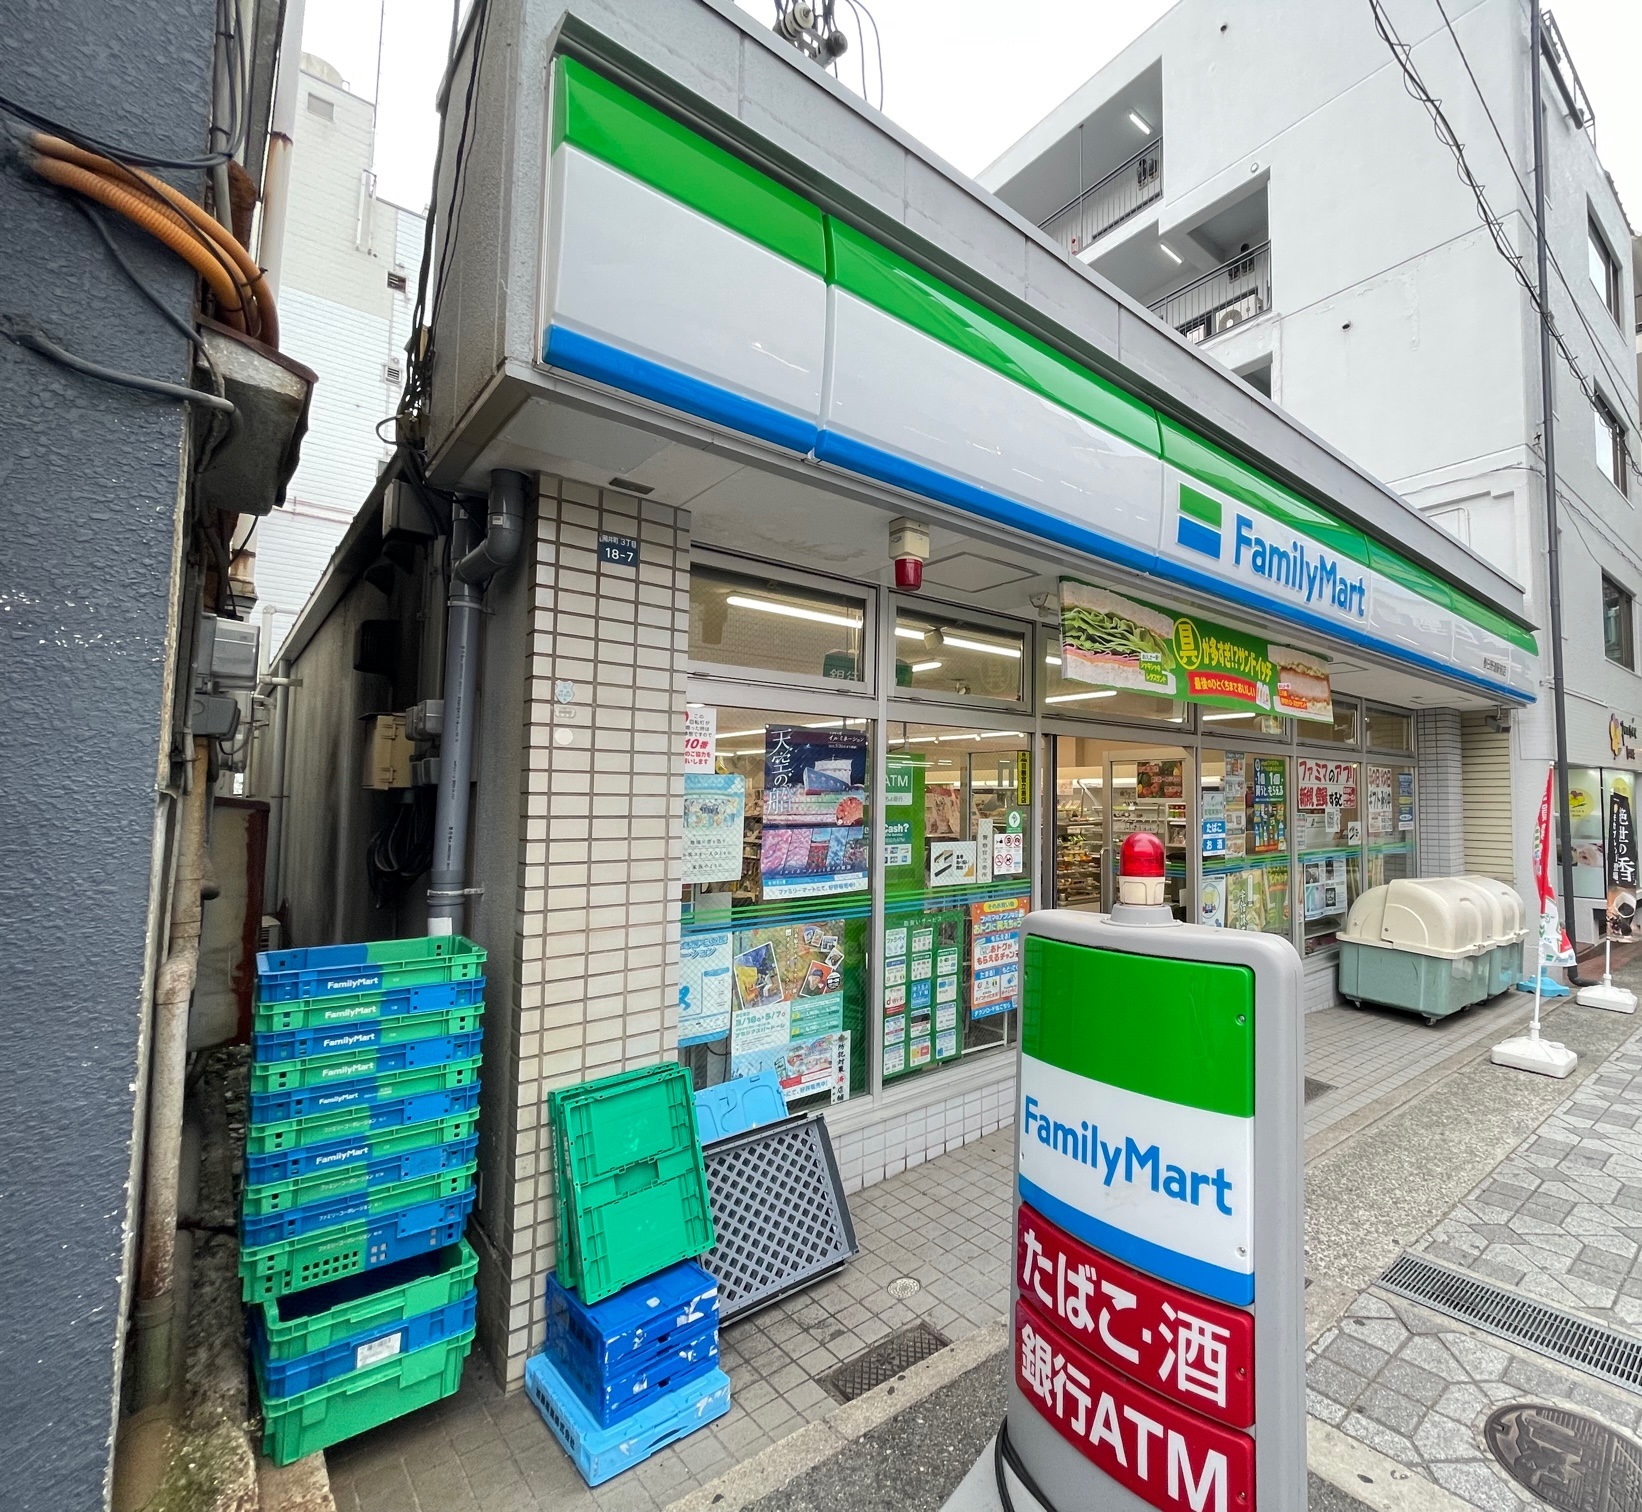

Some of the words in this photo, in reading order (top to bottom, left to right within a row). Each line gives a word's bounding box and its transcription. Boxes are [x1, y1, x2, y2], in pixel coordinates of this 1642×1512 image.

[605, 547, 634, 562] 18-7
[1233, 512, 1366, 618] FamilyMart
[1178, 623, 1199, 664] 具
[828, 734, 865, 744] イルミネーション
[767, 728, 794, 816] 天空の船
[1299, 760, 1356, 784] ファミマのアプリ
[1206, 822, 1223, 833] たばこ
[327, 976, 379, 990] FamilyMart
[324, 1005, 377, 1019] FamilyMart
[323, 1032, 375, 1047] FamilyMart
[322, 1061, 374, 1077] FamilyMart
[318, 1092, 359, 1105] FamilyMart
[316, 1146, 369, 1165] FamilyMart
[1024, 1094, 1233, 1217] FamilyMart
[1022, 1227, 1231, 1409] たばこ・酒
[1020, 1322, 1229, 1512] 銀行ATM
